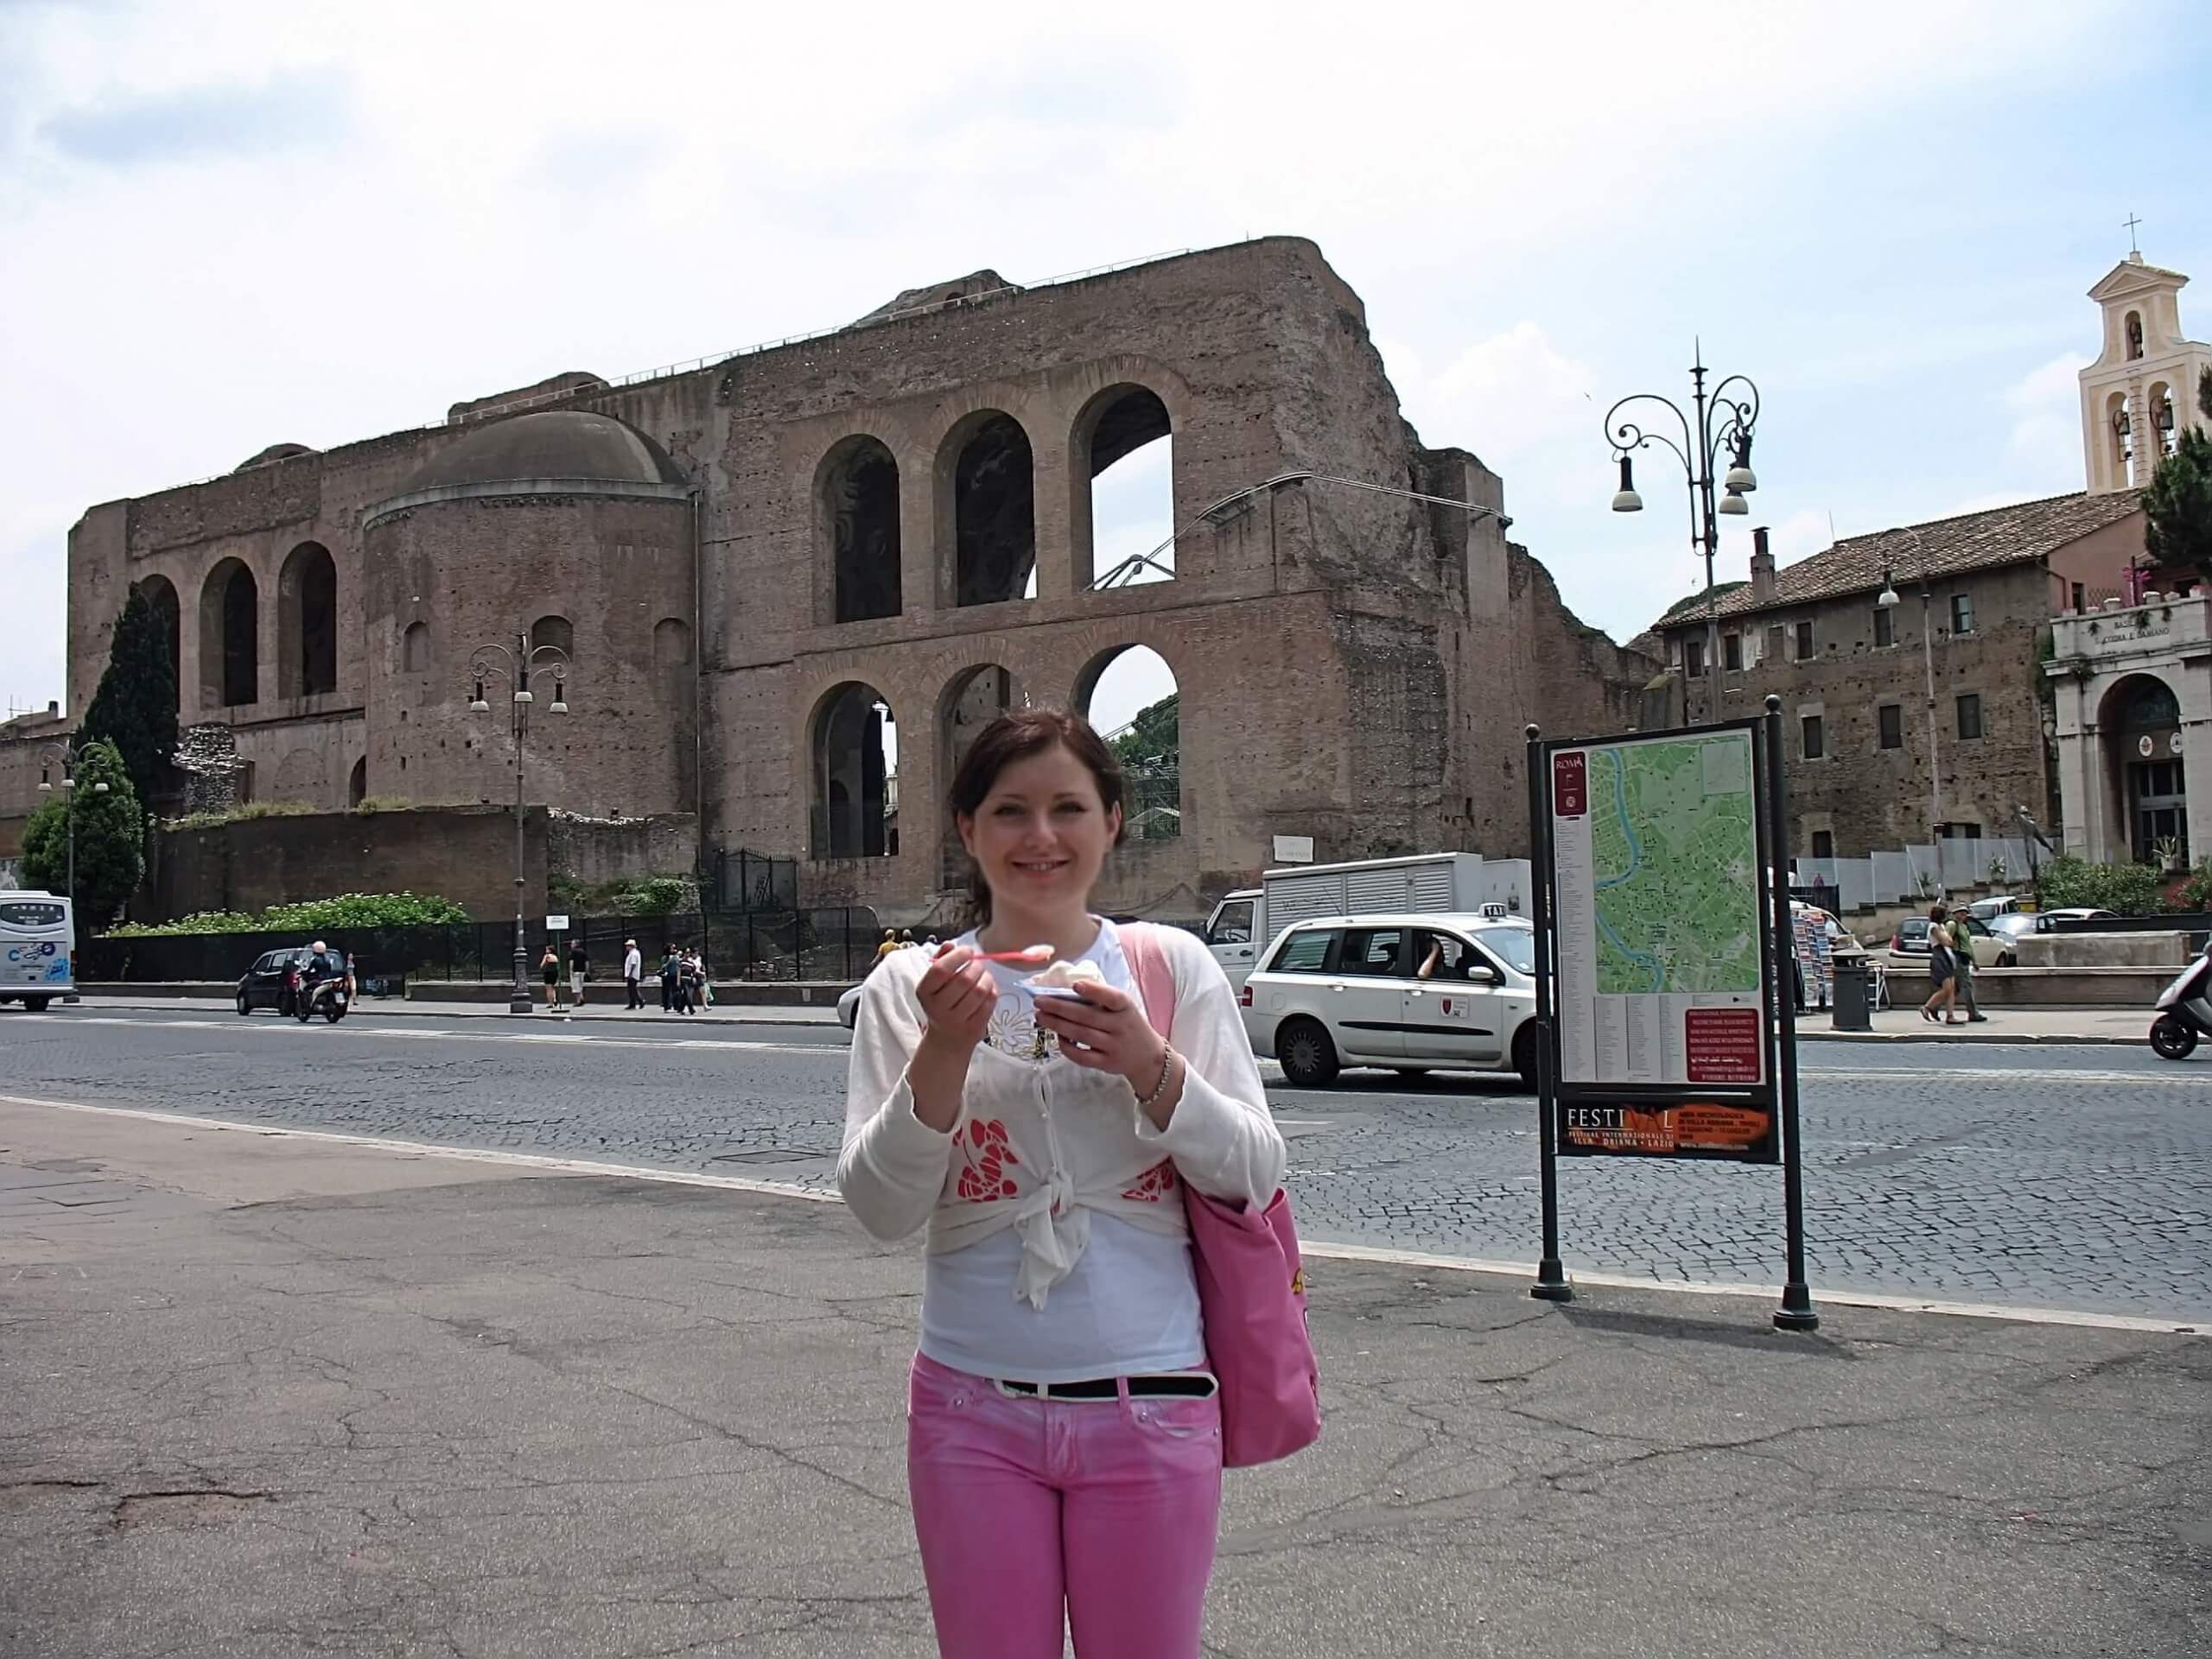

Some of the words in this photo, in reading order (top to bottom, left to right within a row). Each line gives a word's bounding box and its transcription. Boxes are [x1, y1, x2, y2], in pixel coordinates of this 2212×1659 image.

[1555, 756, 1583, 769] ROMA
[1603, 1138, 1638, 1147] DRIANA
[1648, 1139, 1675, 1148] LAZIO
